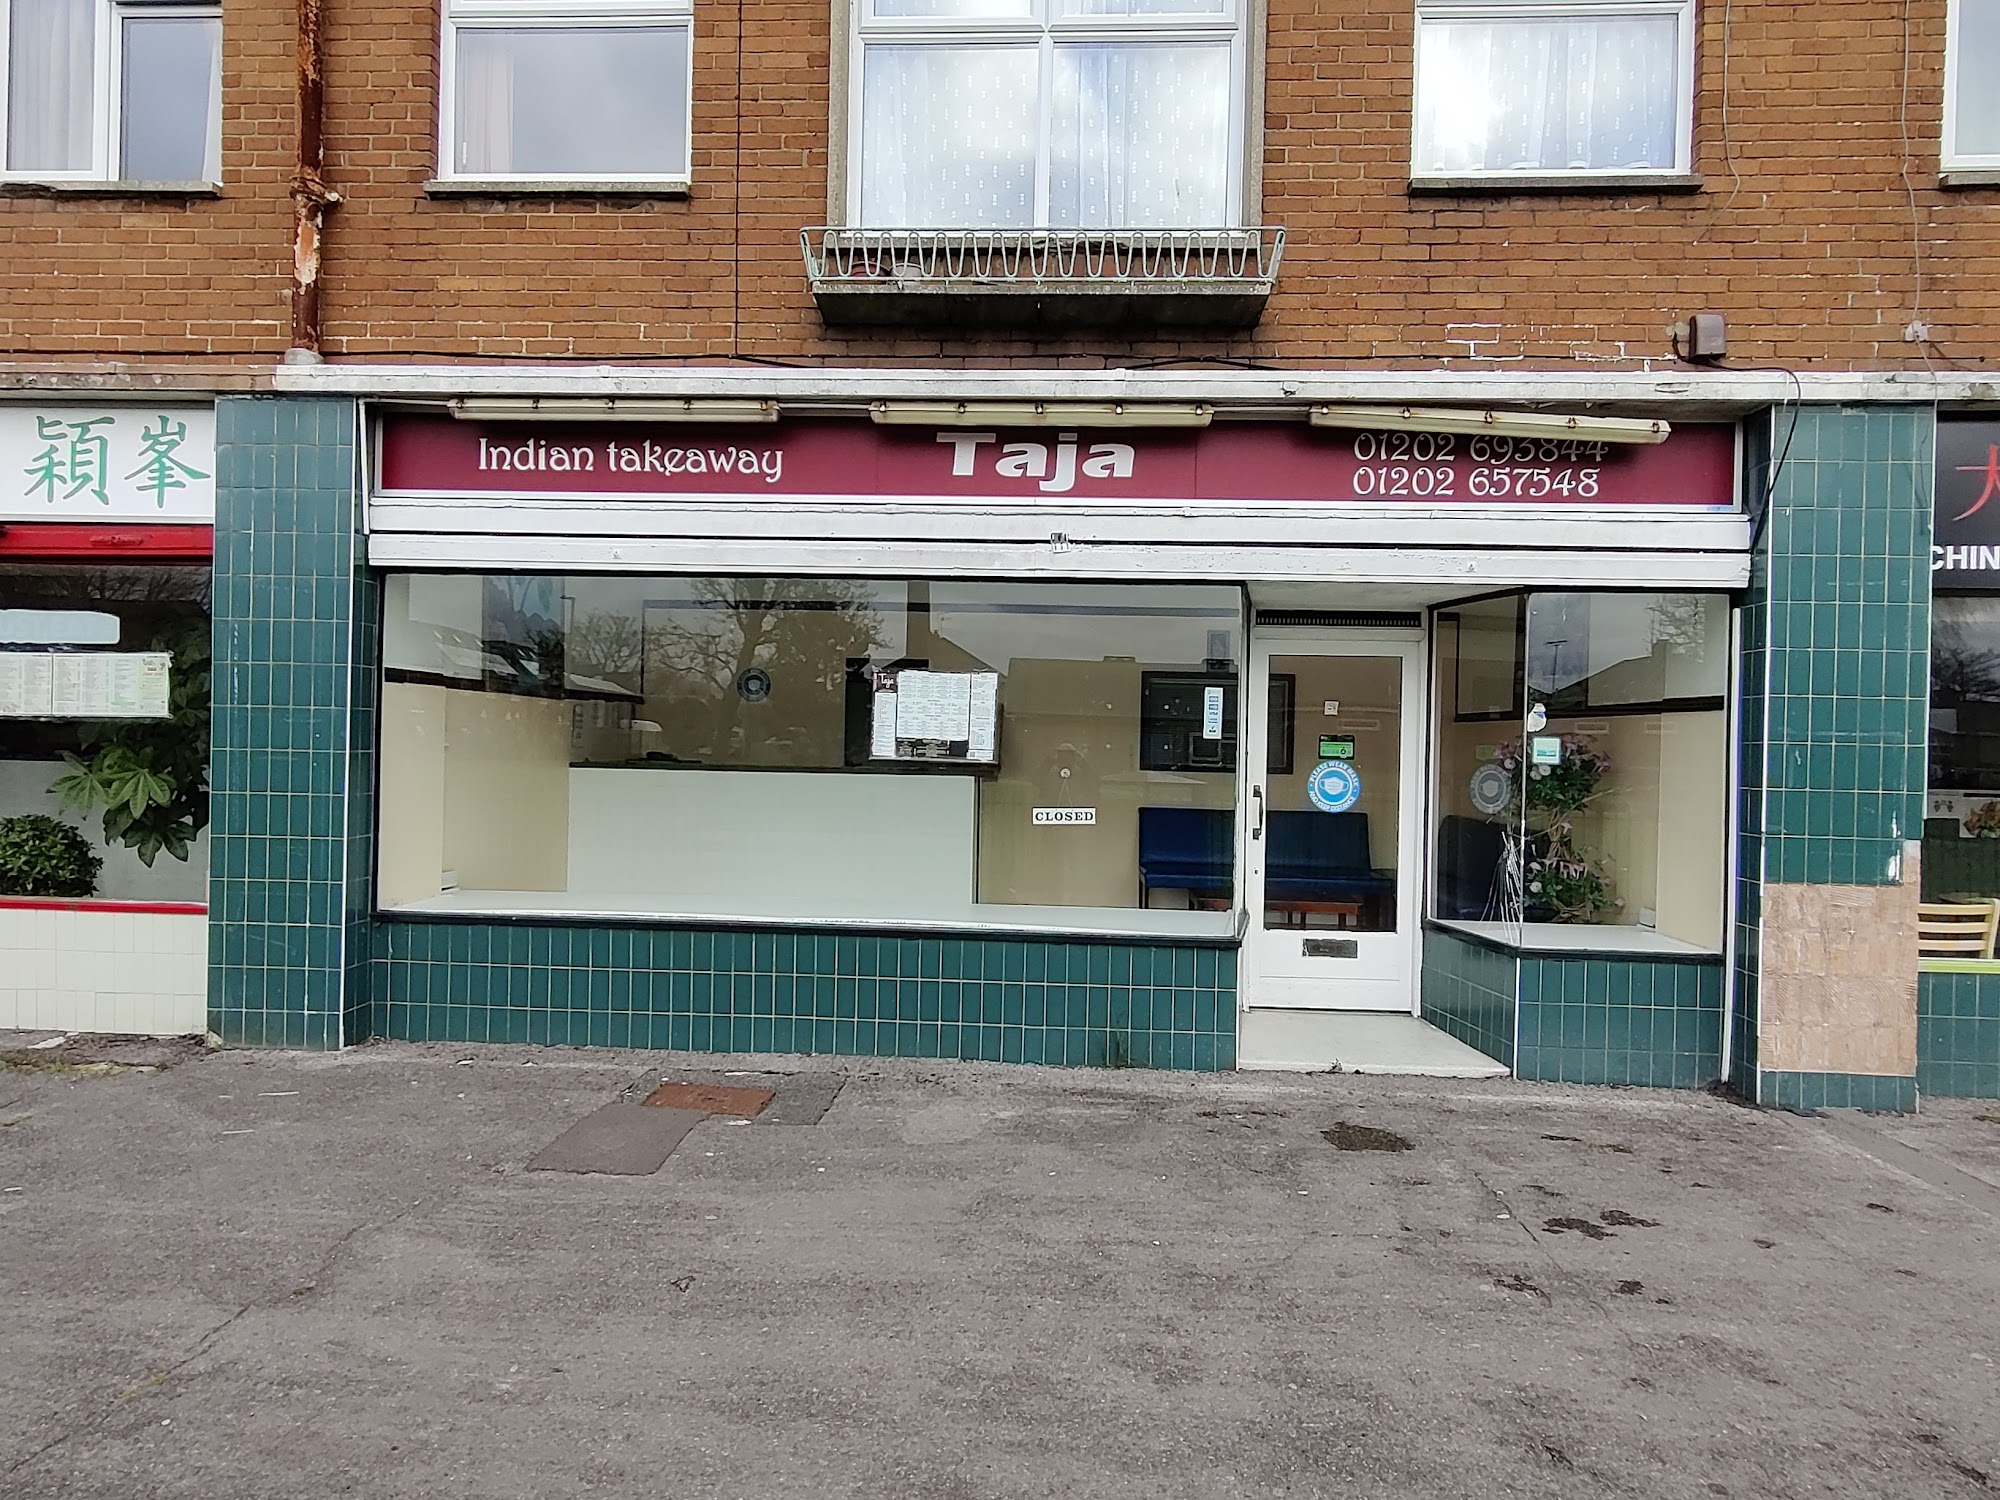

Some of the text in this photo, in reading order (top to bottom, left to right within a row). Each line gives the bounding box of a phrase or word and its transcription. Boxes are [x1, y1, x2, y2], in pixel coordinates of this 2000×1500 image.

[478, 437, 783, 483] Indian takeaway
[936, 432, 1135, 492] Taja
[1353, 432, 1609, 464] 01202 693844
[1352, 466, 1600, 497] 01202 657548
[1035, 811, 1094, 822] CLOSED
